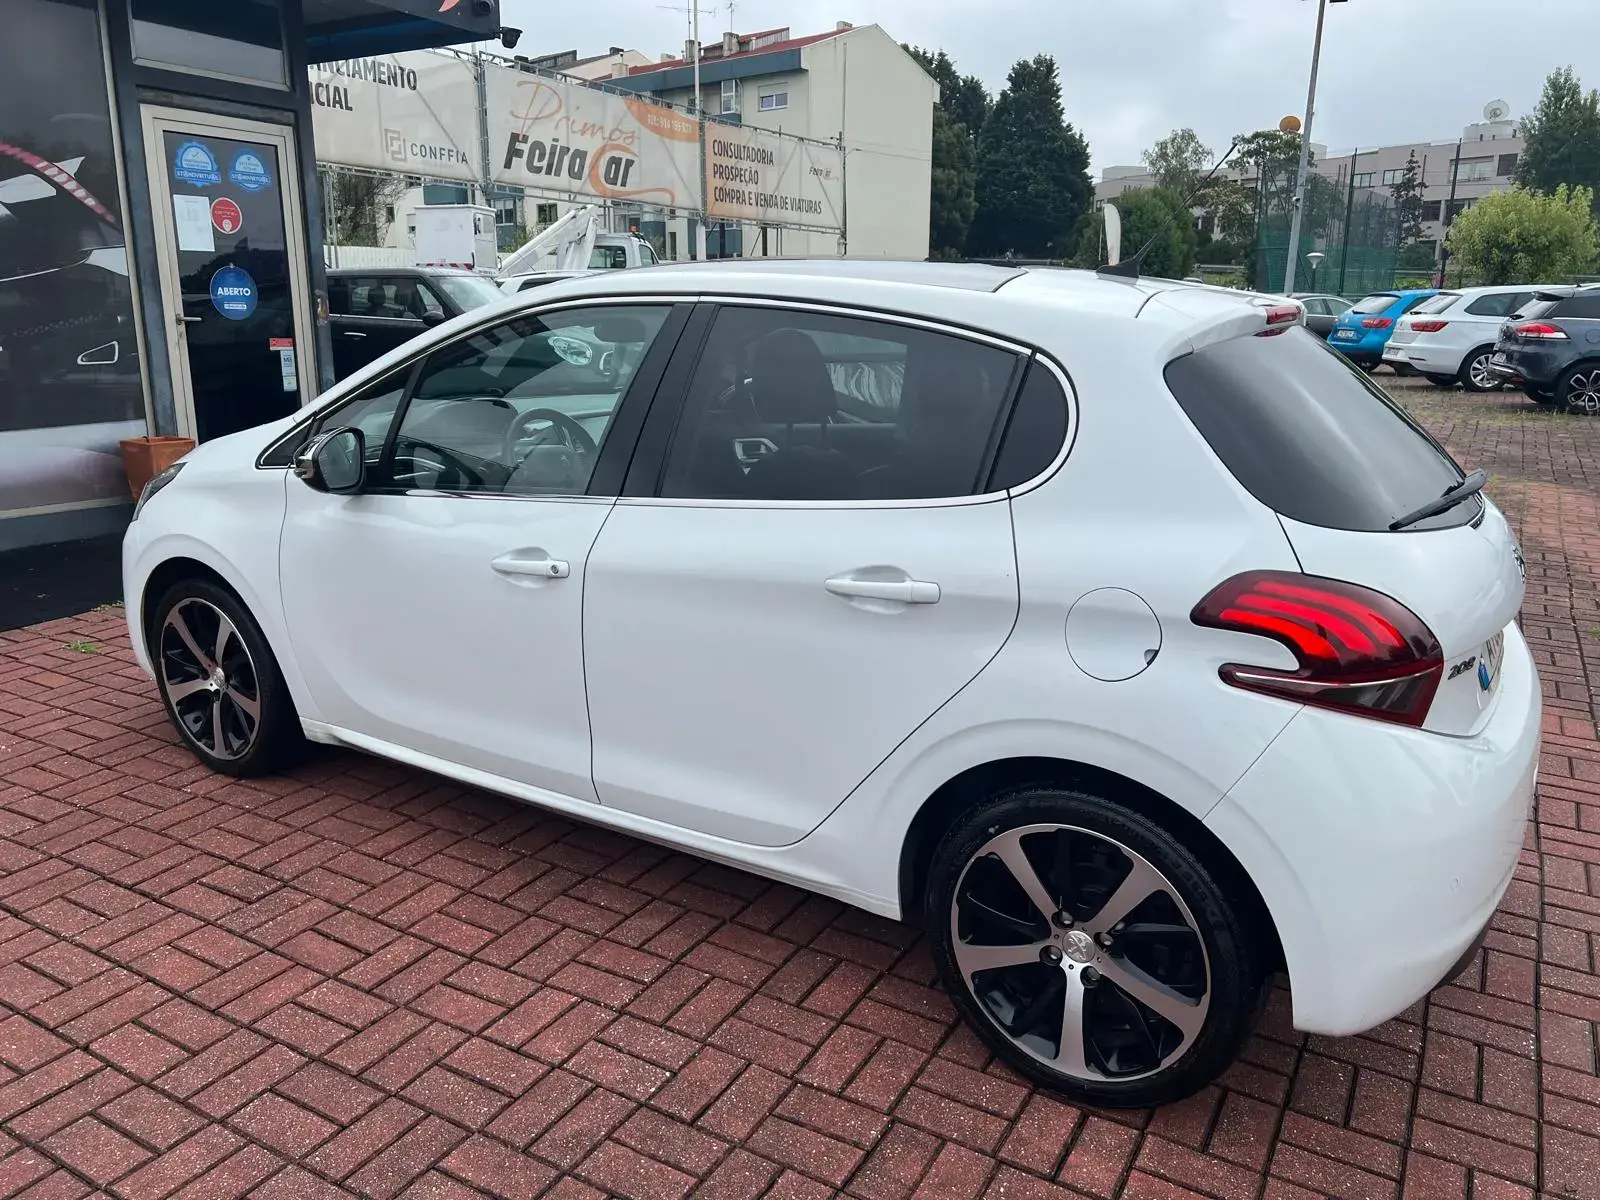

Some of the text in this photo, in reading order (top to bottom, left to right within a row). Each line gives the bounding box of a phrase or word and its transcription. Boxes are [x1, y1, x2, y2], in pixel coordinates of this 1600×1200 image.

[510, 80, 640, 146] Primos
[410, 142, 469, 165] CONFFIA
[712, 139, 774, 166] CONSULTADORIA
[713, 163, 759, 186] PROSPEÇÃO
[713, 186, 822, 215] COMPRA E VENDA DE VIATURAS
[217, 286, 251, 297] ABERTO
[1447, 655, 1476, 681] 208
